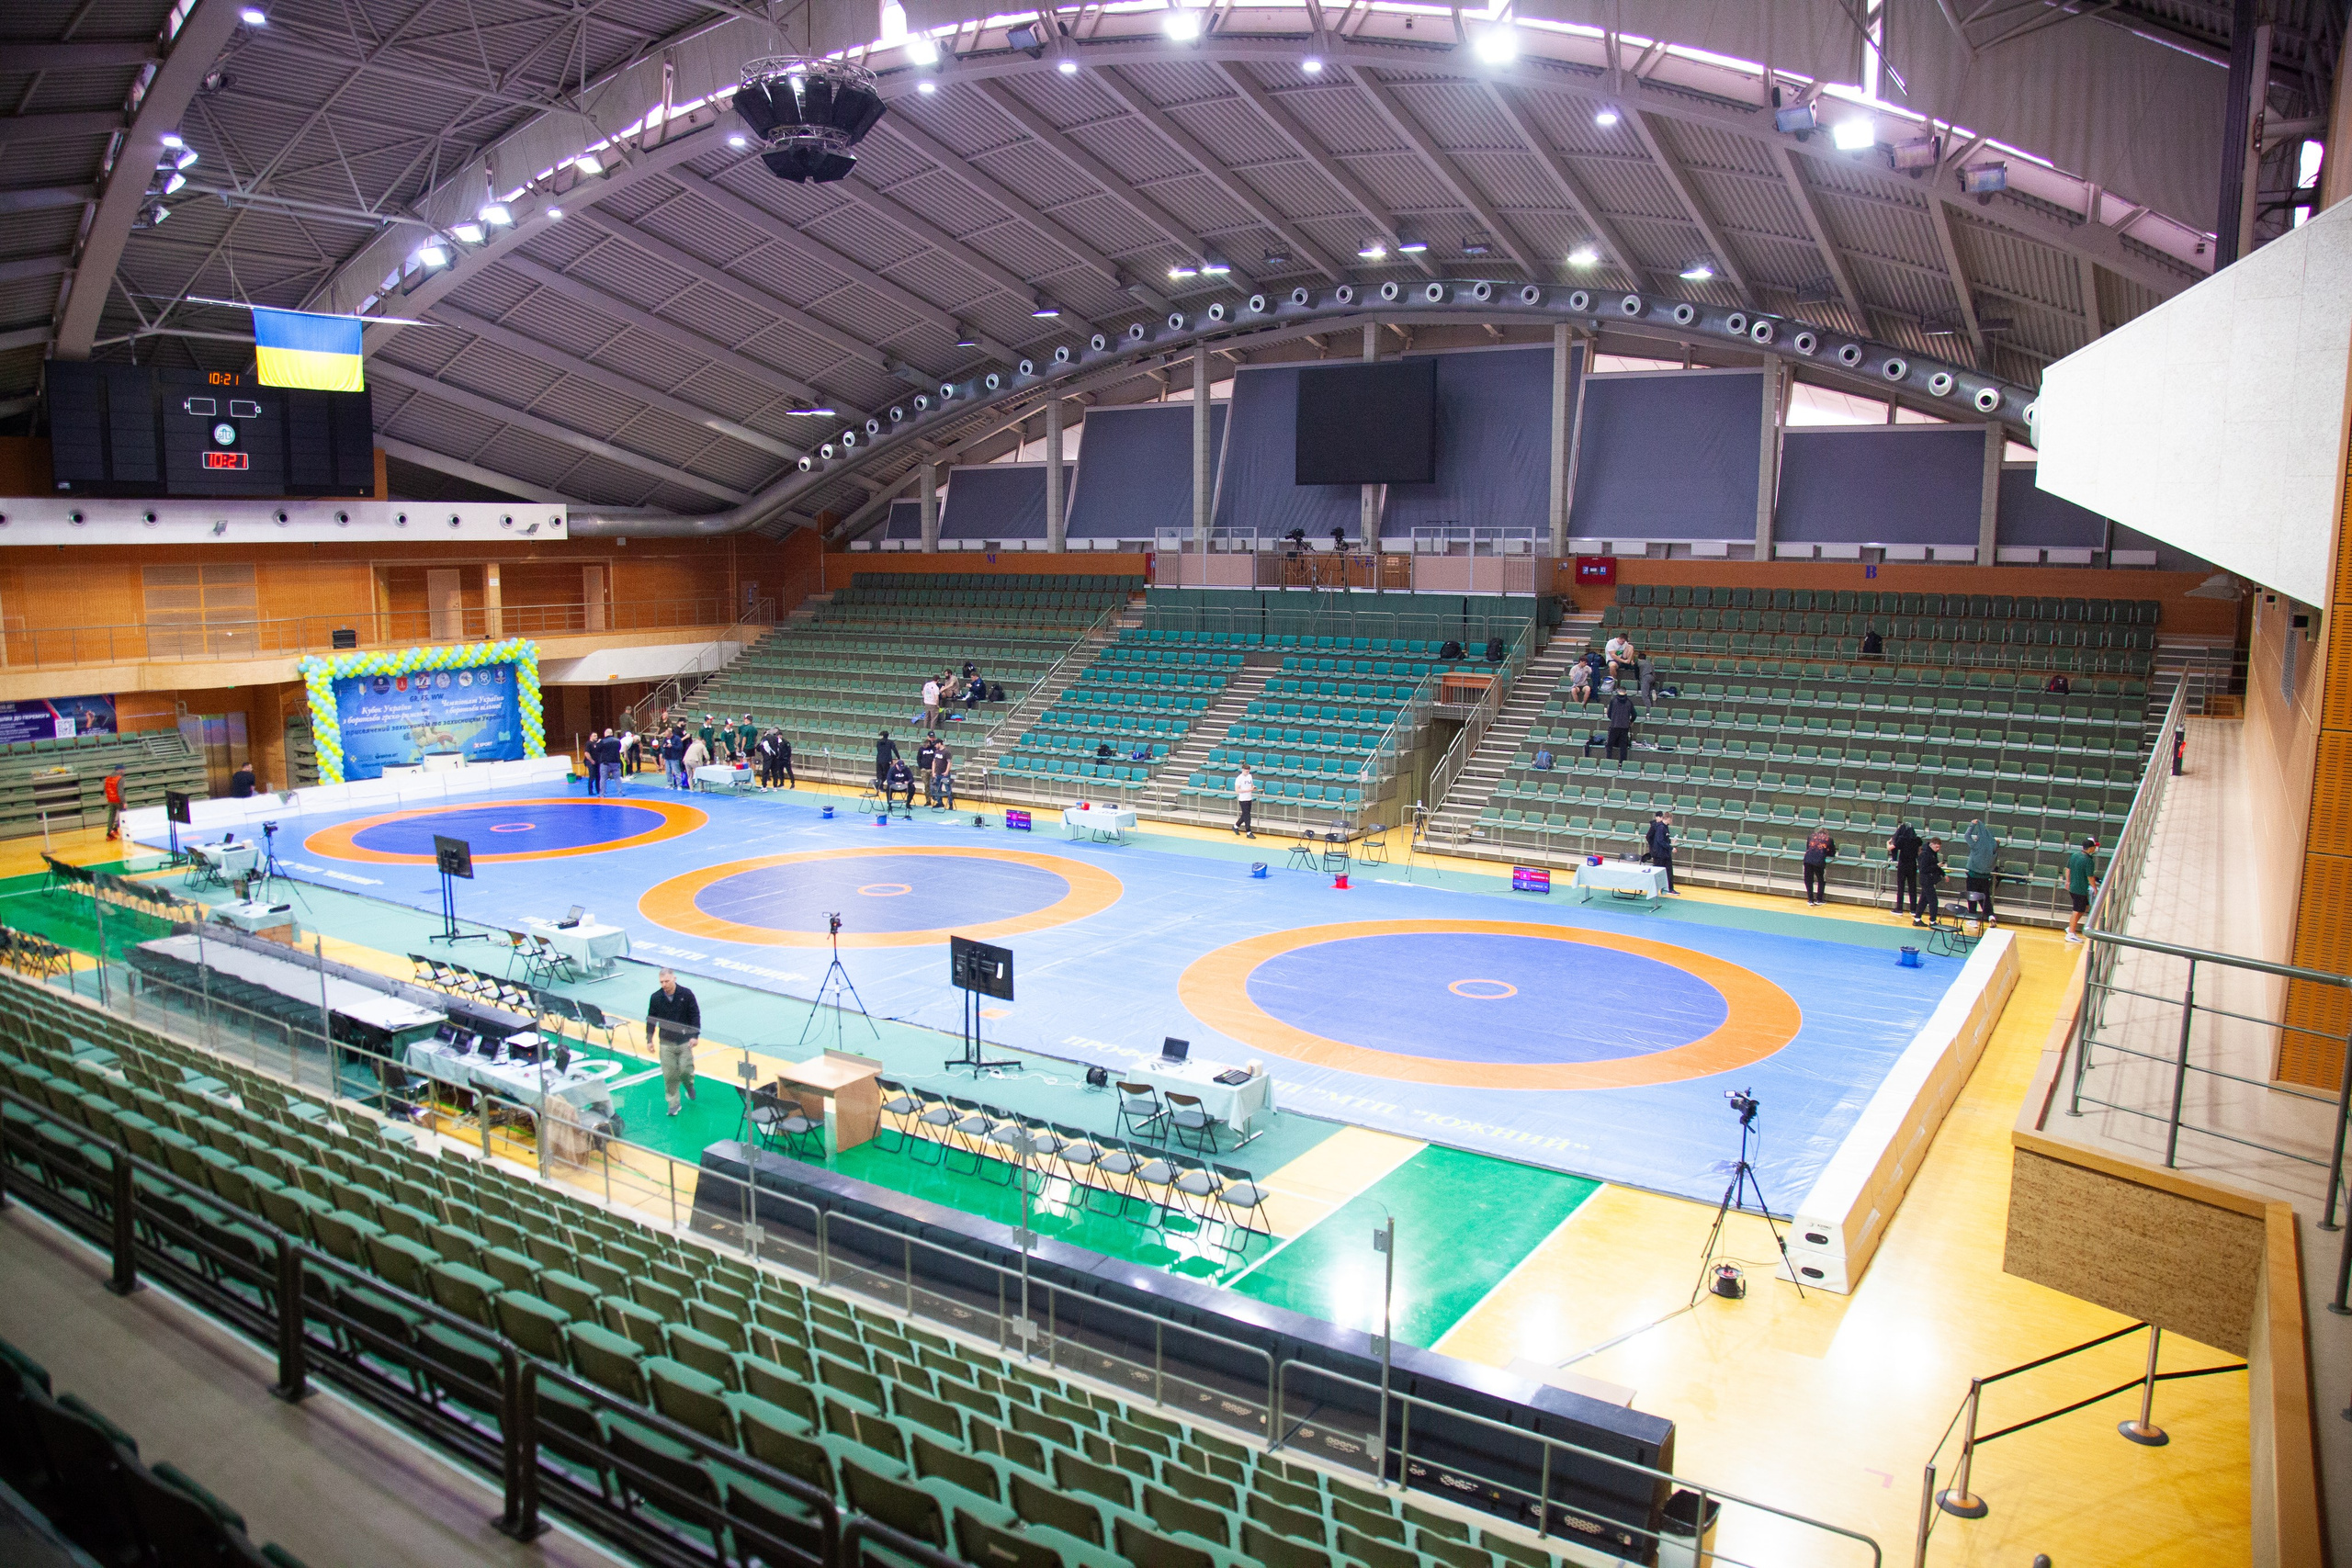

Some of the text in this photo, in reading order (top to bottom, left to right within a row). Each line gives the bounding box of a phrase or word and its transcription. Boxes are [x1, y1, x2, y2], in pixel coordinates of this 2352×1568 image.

[209, 372, 240, 386] 10:21
[208, 453, 248, 468] 10:21
[361, 704, 413, 716] Кубок України
